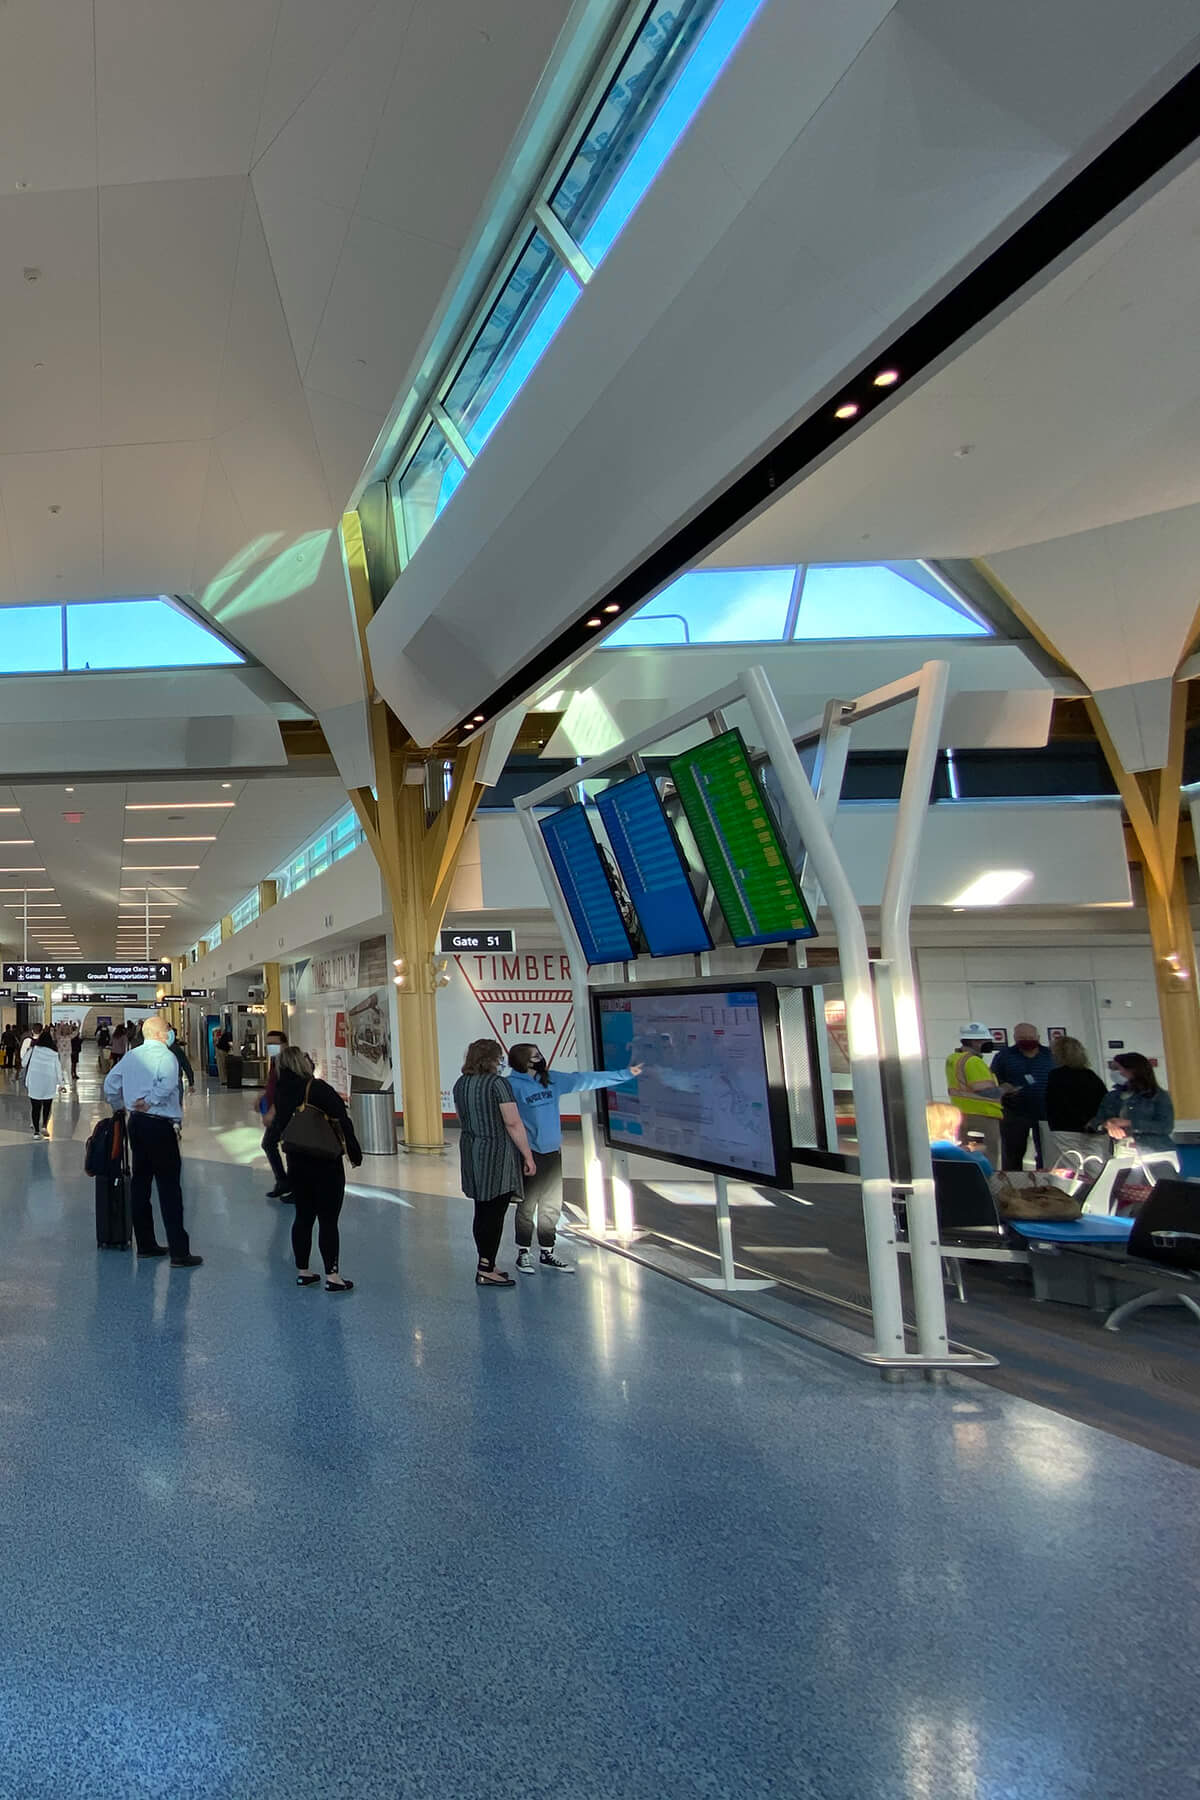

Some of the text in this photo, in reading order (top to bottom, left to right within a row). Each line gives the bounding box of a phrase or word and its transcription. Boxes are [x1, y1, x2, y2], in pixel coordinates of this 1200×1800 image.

[452, 936, 500, 946] Gate 51
[472, 955, 572, 980] TIMBER
[502, 1012, 556, 1034] PIZZA
